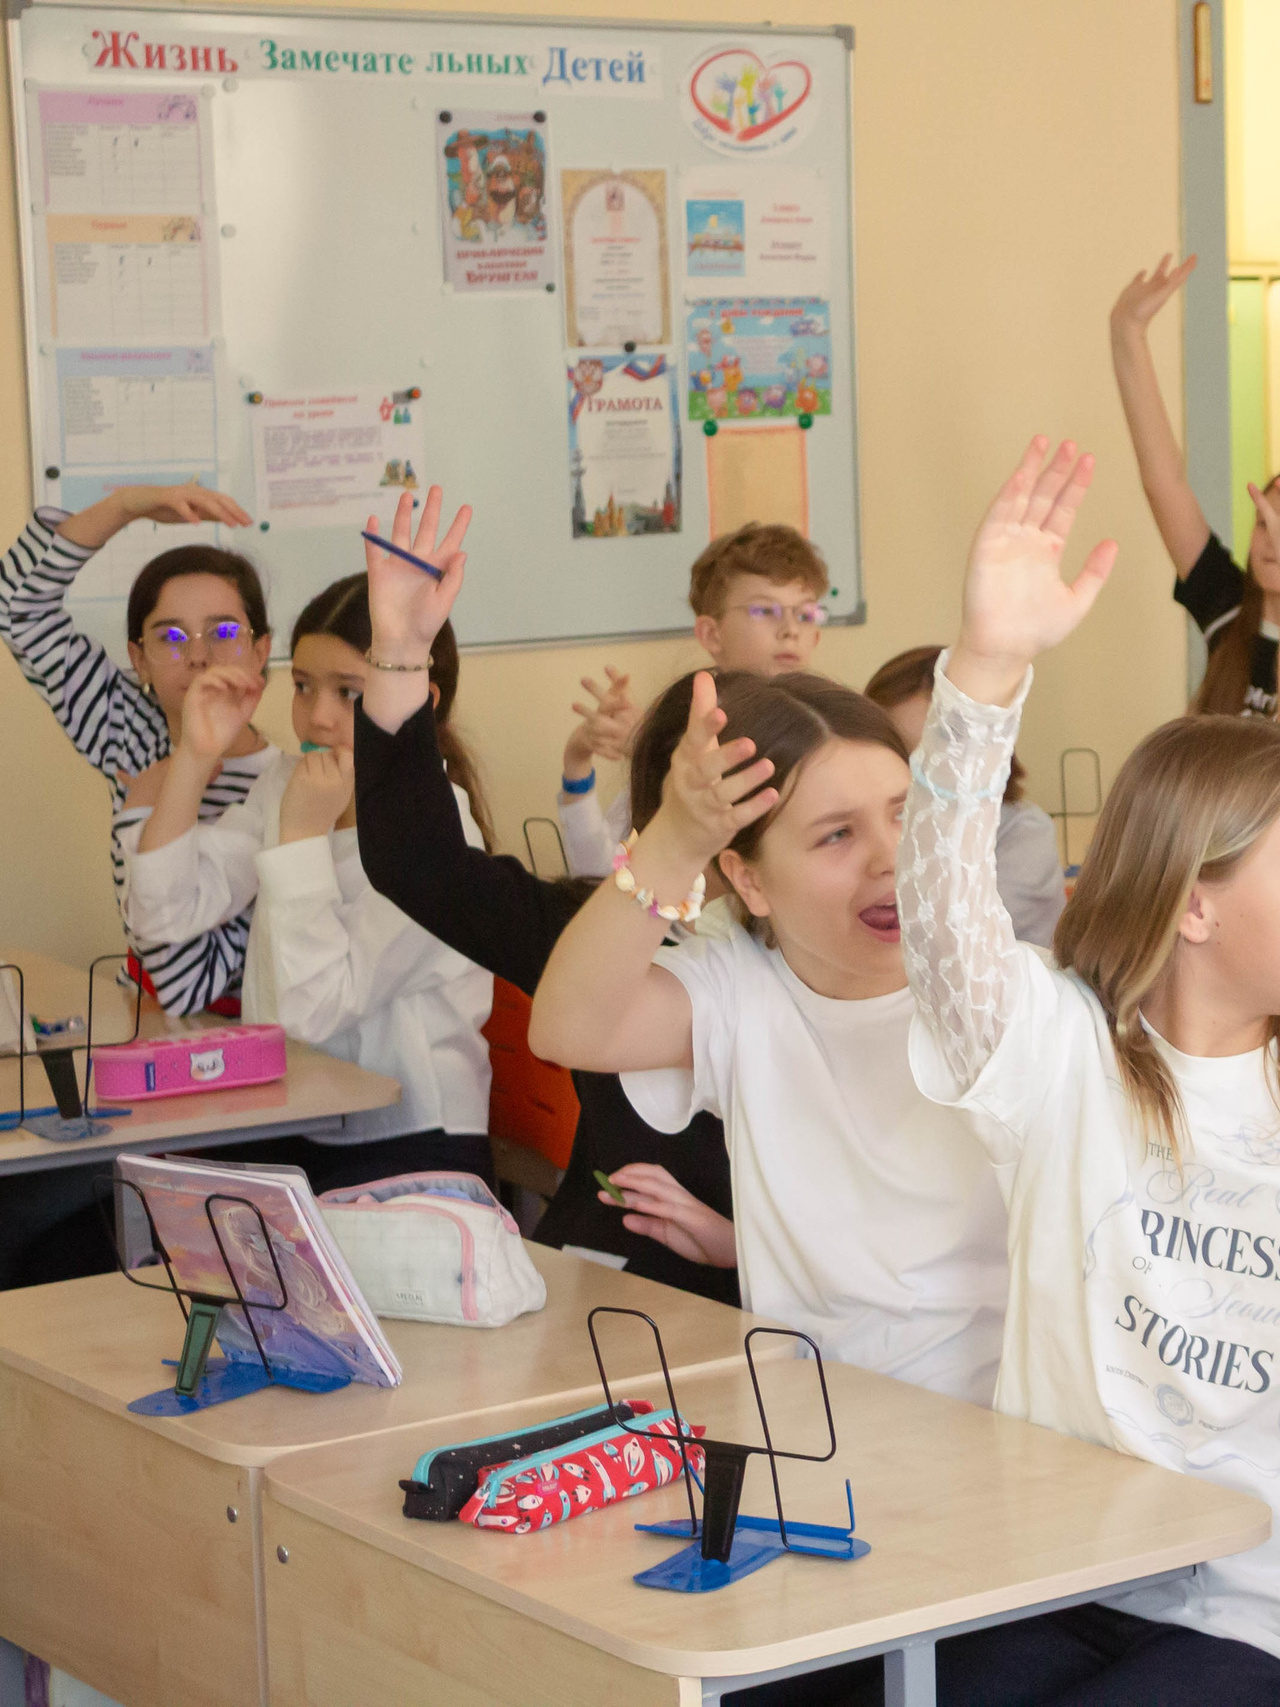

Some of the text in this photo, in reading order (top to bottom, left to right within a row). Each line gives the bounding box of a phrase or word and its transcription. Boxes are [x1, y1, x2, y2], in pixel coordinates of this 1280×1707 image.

[91, 30, 239, 73] Жизнь
[542, 47, 646, 86] Детей
[587, 396, 663, 412] ГРАМОТА
[1149, 1142, 1174, 1161] THE
[1146, 1163, 1268, 1212] Real
[1115, 1295, 1275, 1394] STORIES
